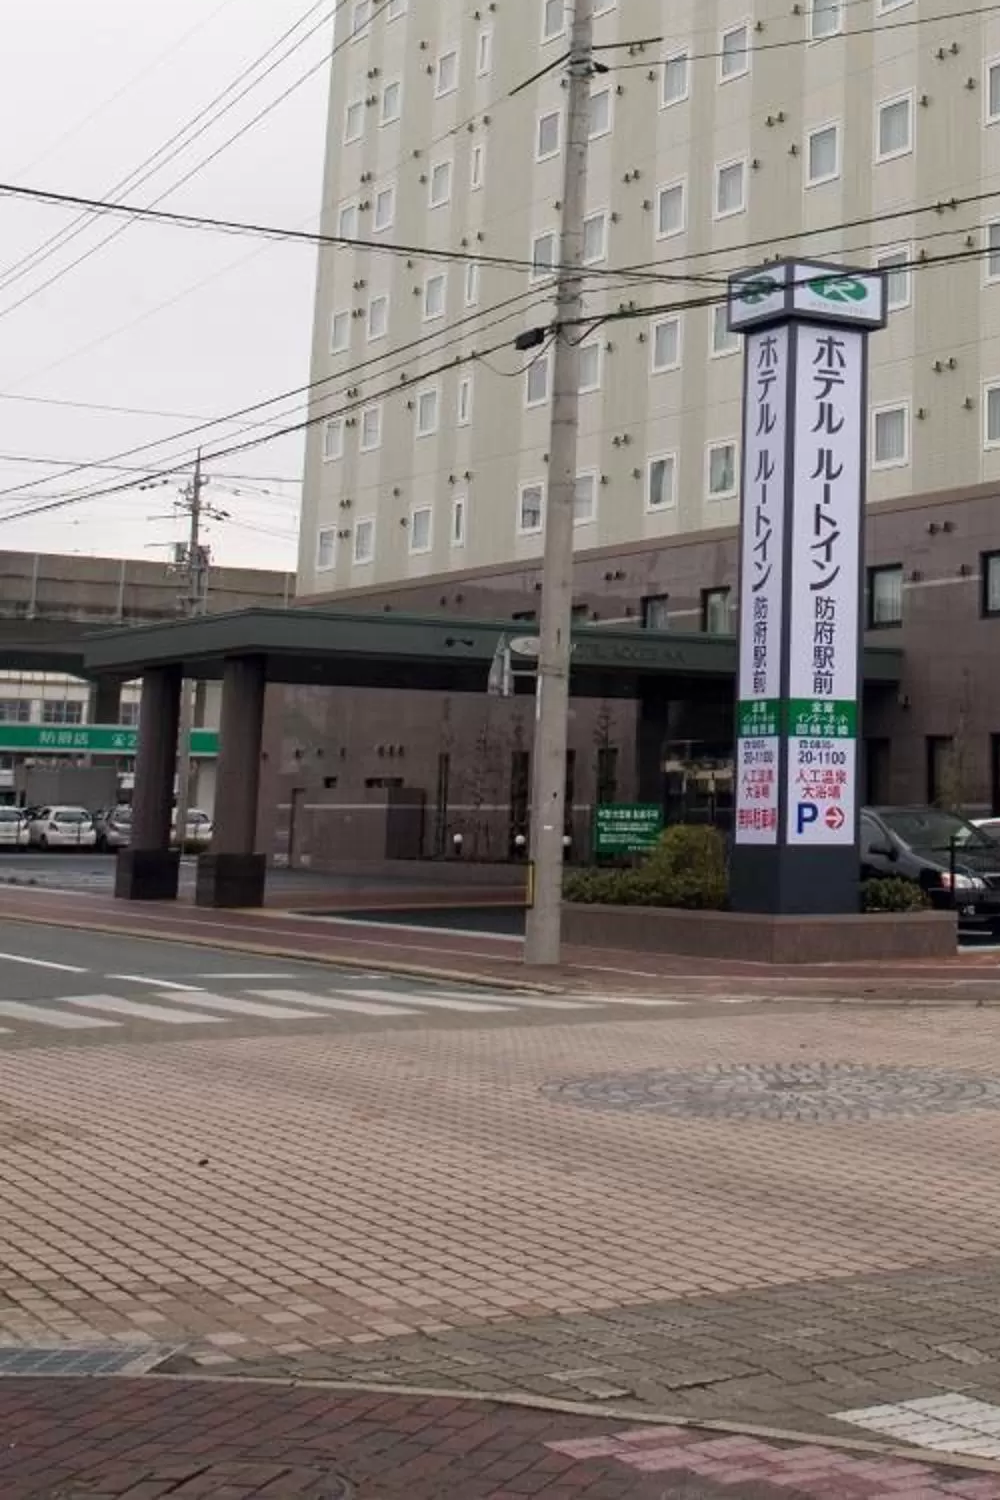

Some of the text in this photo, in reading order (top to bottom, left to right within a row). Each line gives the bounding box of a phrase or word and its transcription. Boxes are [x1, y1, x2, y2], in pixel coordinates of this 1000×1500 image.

[755, 336, 778, 436] ホテル
[810, 335, 846, 435] ホテル
[809, 448, 843, 591] ルートイン
[812, 596, 836, 695] 防府駅前
[797, 802, 819, 834] P
